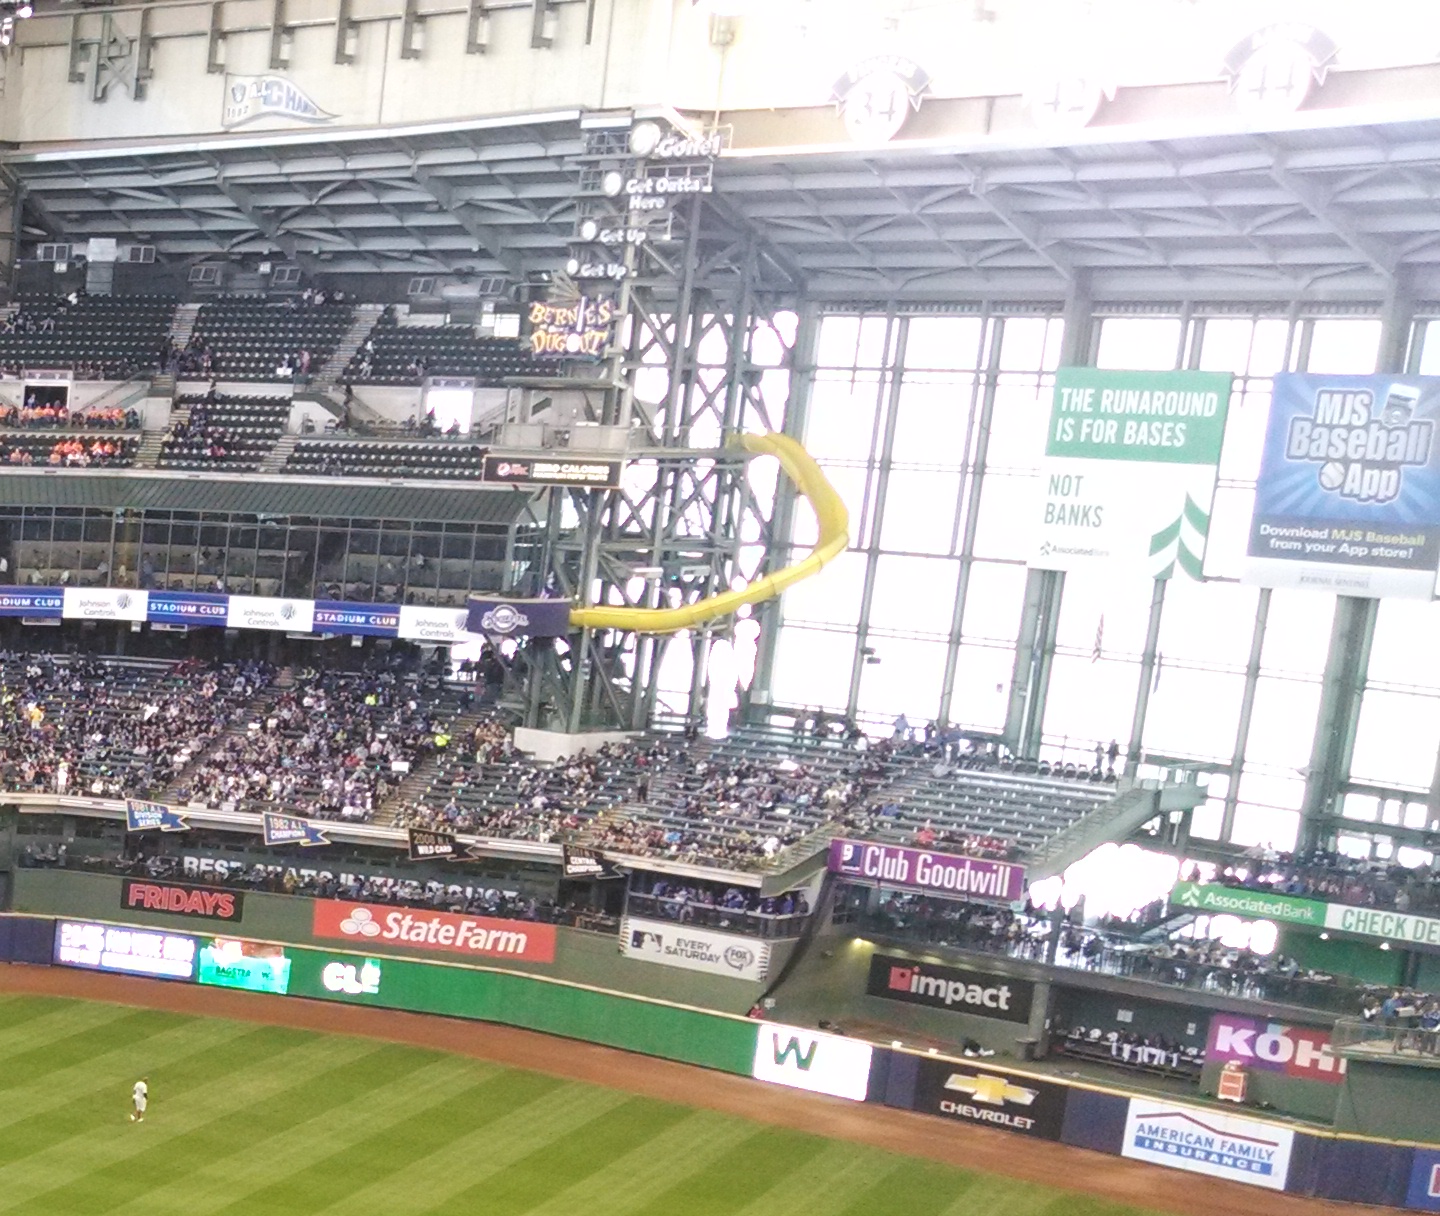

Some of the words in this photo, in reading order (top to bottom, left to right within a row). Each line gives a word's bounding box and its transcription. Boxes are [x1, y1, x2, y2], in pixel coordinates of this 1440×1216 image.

[626, 179, 653, 193] Get
[656, 178, 700, 192] Outta
[629, 196, 666, 209] Here
[599, 229, 624, 242] Get
[626, 227, 647, 246] Up
[580, 264, 604, 277] Get
[606, 262, 627, 280] Up
[1061, 388, 1095, 412] THE
[1100, 389, 1218, 417] RUNAROUND
[1316, 392, 1371, 426] MJS
[1055, 417, 1075, 442] IS
[1080, 419, 1119, 444] FOR
[1123, 421, 1187, 447] BASES
[1288, 420, 1431, 463] Baseball
[1048, 474, 1084, 497] NOT
[1343, 462, 1399, 501] App
[1044, 502, 1104, 528] BANKS
[1260, 524, 1329, 540] Download
[1331, 528, 1362, 541] MJS
[1366, 530, 1426, 546] Baseball
[1270, 538, 1302, 550] from
[1305, 542, 1336, 554] your
[1338, 541, 1369, 558] App
[1371, 546, 1413, 559] store!
[34, 597, 61, 607] CLUB
[79, 599, 112, 609] Johnson
[150, 602, 196, 613] STADIUM
[199, 605, 226, 615] CLUB
[84, 607, 116, 617] Controls
[243, 608, 274, 618] Johnson
[247, 616, 280, 626] Controls
[316, 612, 366, 623] STADIUM
[369, 614, 397, 625] CLUB
[415, 618, 449, 629] Johnson
[420, 627, 454, 638] Controls
[270, 818, 290, 830] 1982
[864, 846, 909, 881] Club
[915, 854, 1011, 898] Goodwill
[128, 883, 235, 918] FRIDAYS
[1341, 908, 1408, 937] CHECK
[664, 945, 721, 963] SATURDAY
[676, 938, 712, 951] EVERY
[730, 949, 747, 960] FOX
[909, 965, 1012, 1011] impact
[940, 1100, 1035, 1130] CHEVROLET
[1136, 1122, 1215, 1149] AMERICAN
[1220, 1139, 1275, 1162] FAMILY
[1143, 1139, 1262, 1172] INSURANCE
